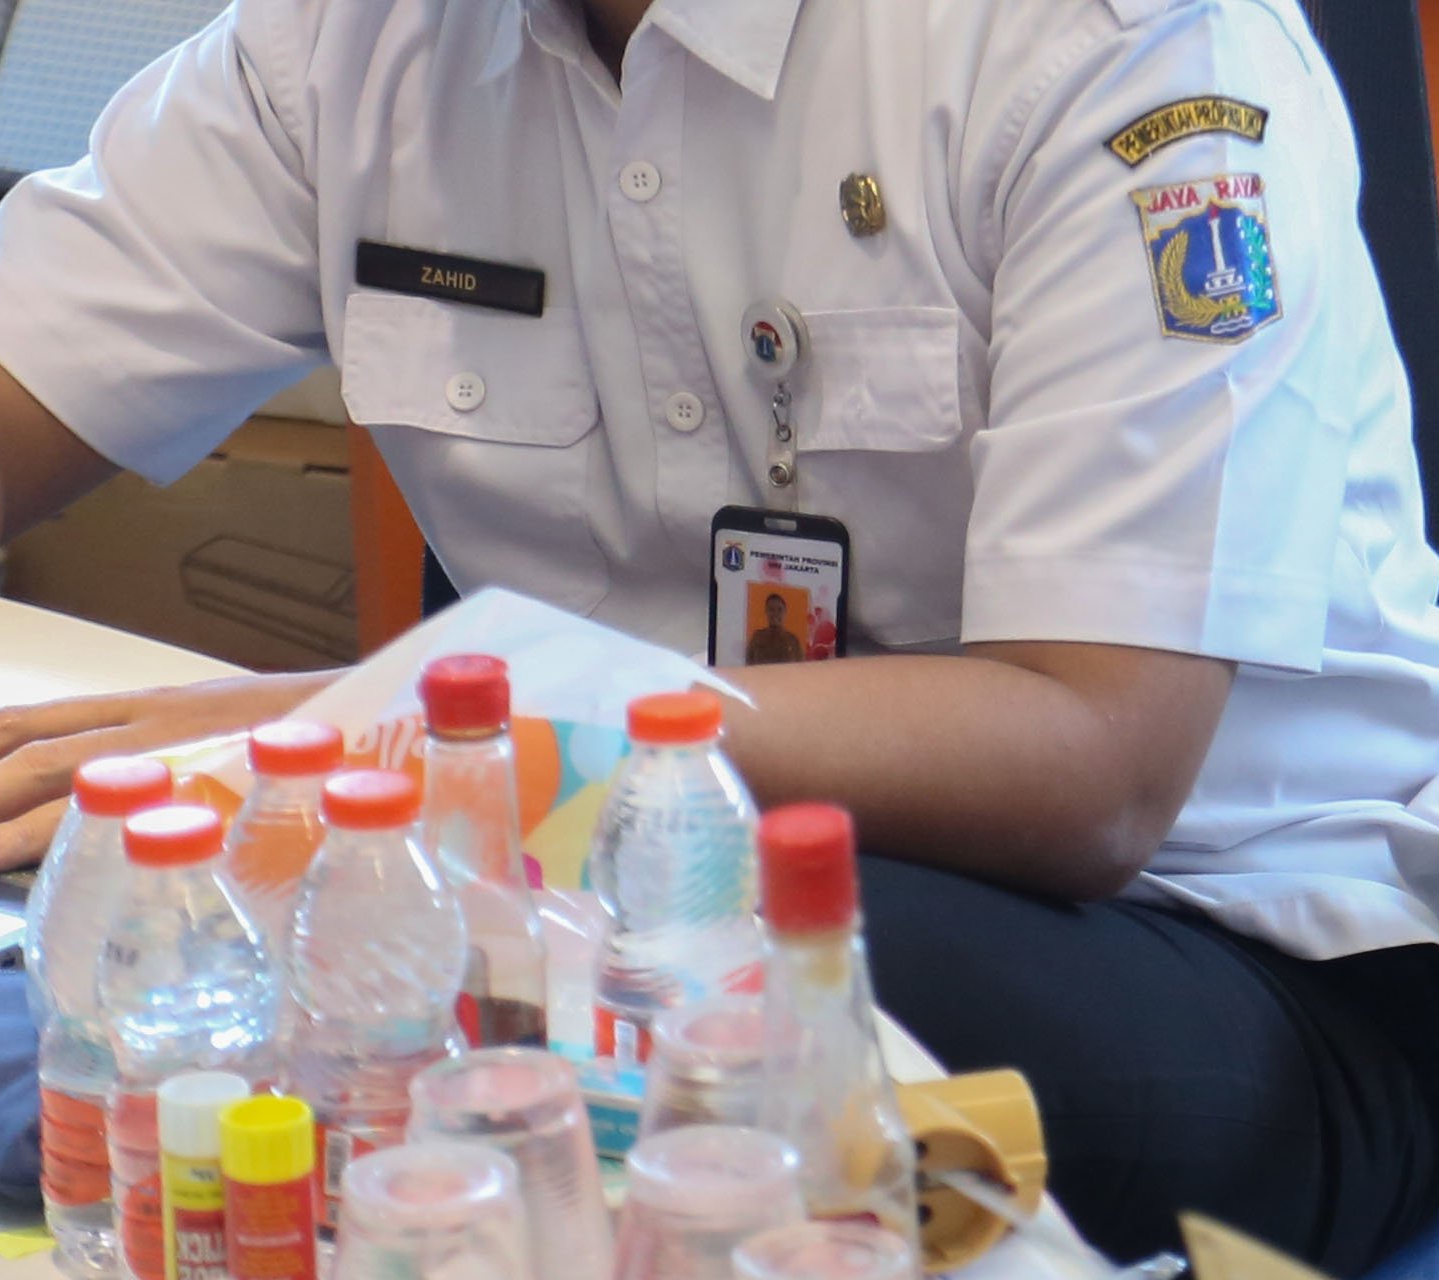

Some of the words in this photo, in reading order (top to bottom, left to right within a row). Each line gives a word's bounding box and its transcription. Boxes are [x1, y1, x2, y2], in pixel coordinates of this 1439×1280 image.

[1147, 185, 1202, 214] JAYA
[1214, 175, 1264, 200] RAYA
[421, 267, 477, 291] ZAHID
